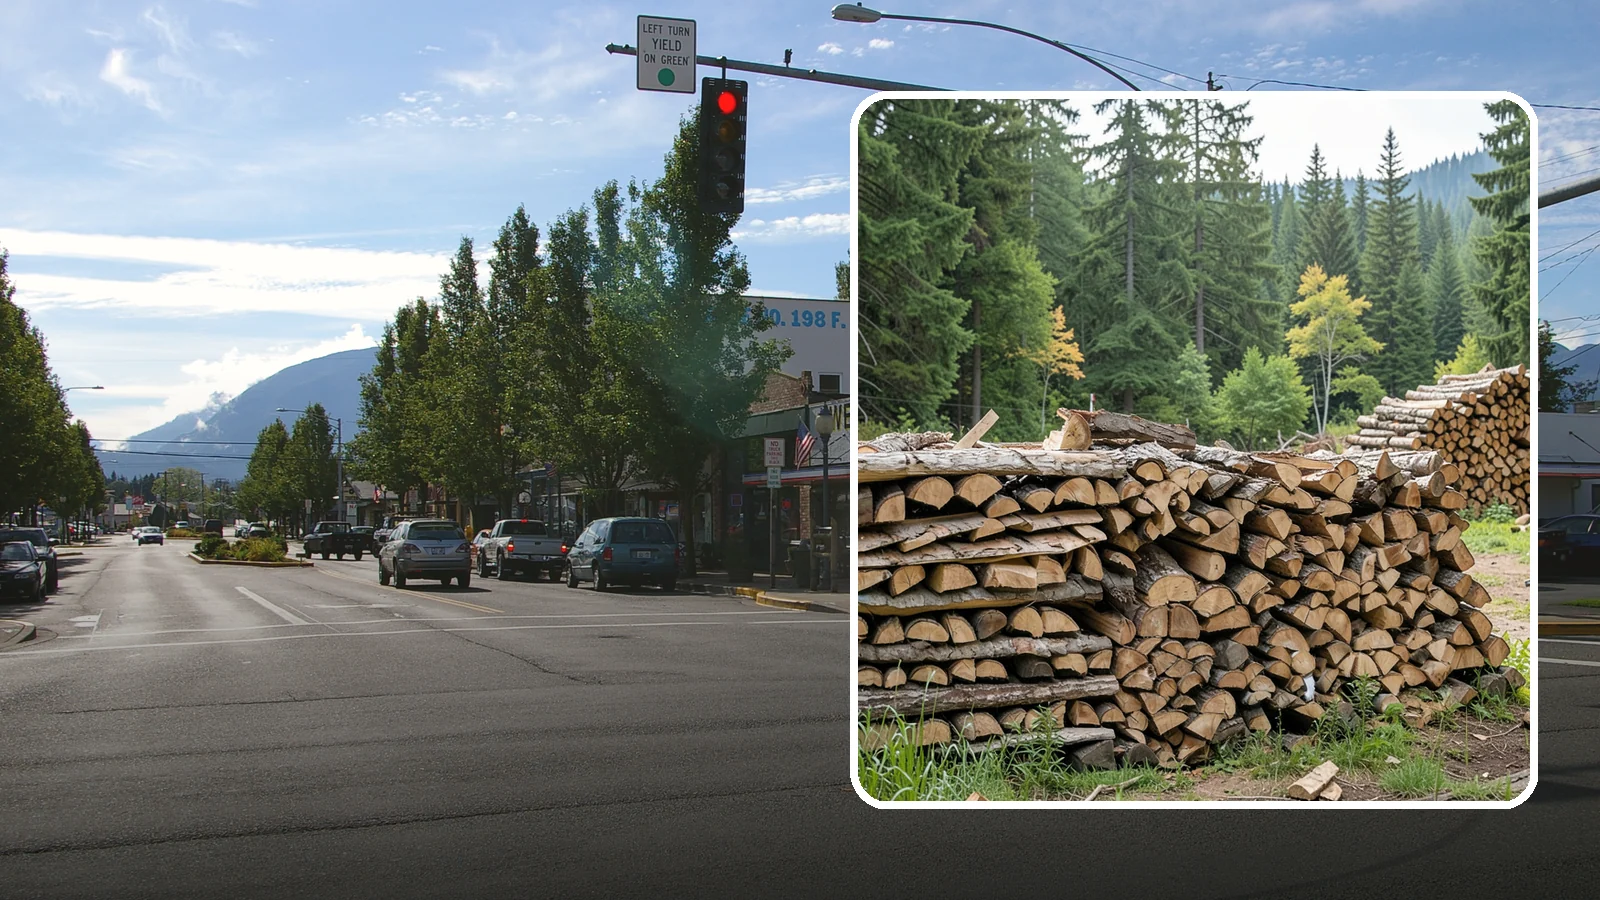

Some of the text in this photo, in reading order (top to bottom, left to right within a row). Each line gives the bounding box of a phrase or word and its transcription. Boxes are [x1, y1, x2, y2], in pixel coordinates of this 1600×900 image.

[642, 23, 690, 36] LEFT TURN
[652, 37, 682, 52] YIELD
[644, 53, 689, 66] ON GREEN
[791, 309, 826, 328] 198
[831, 311, 846, 329] F.
